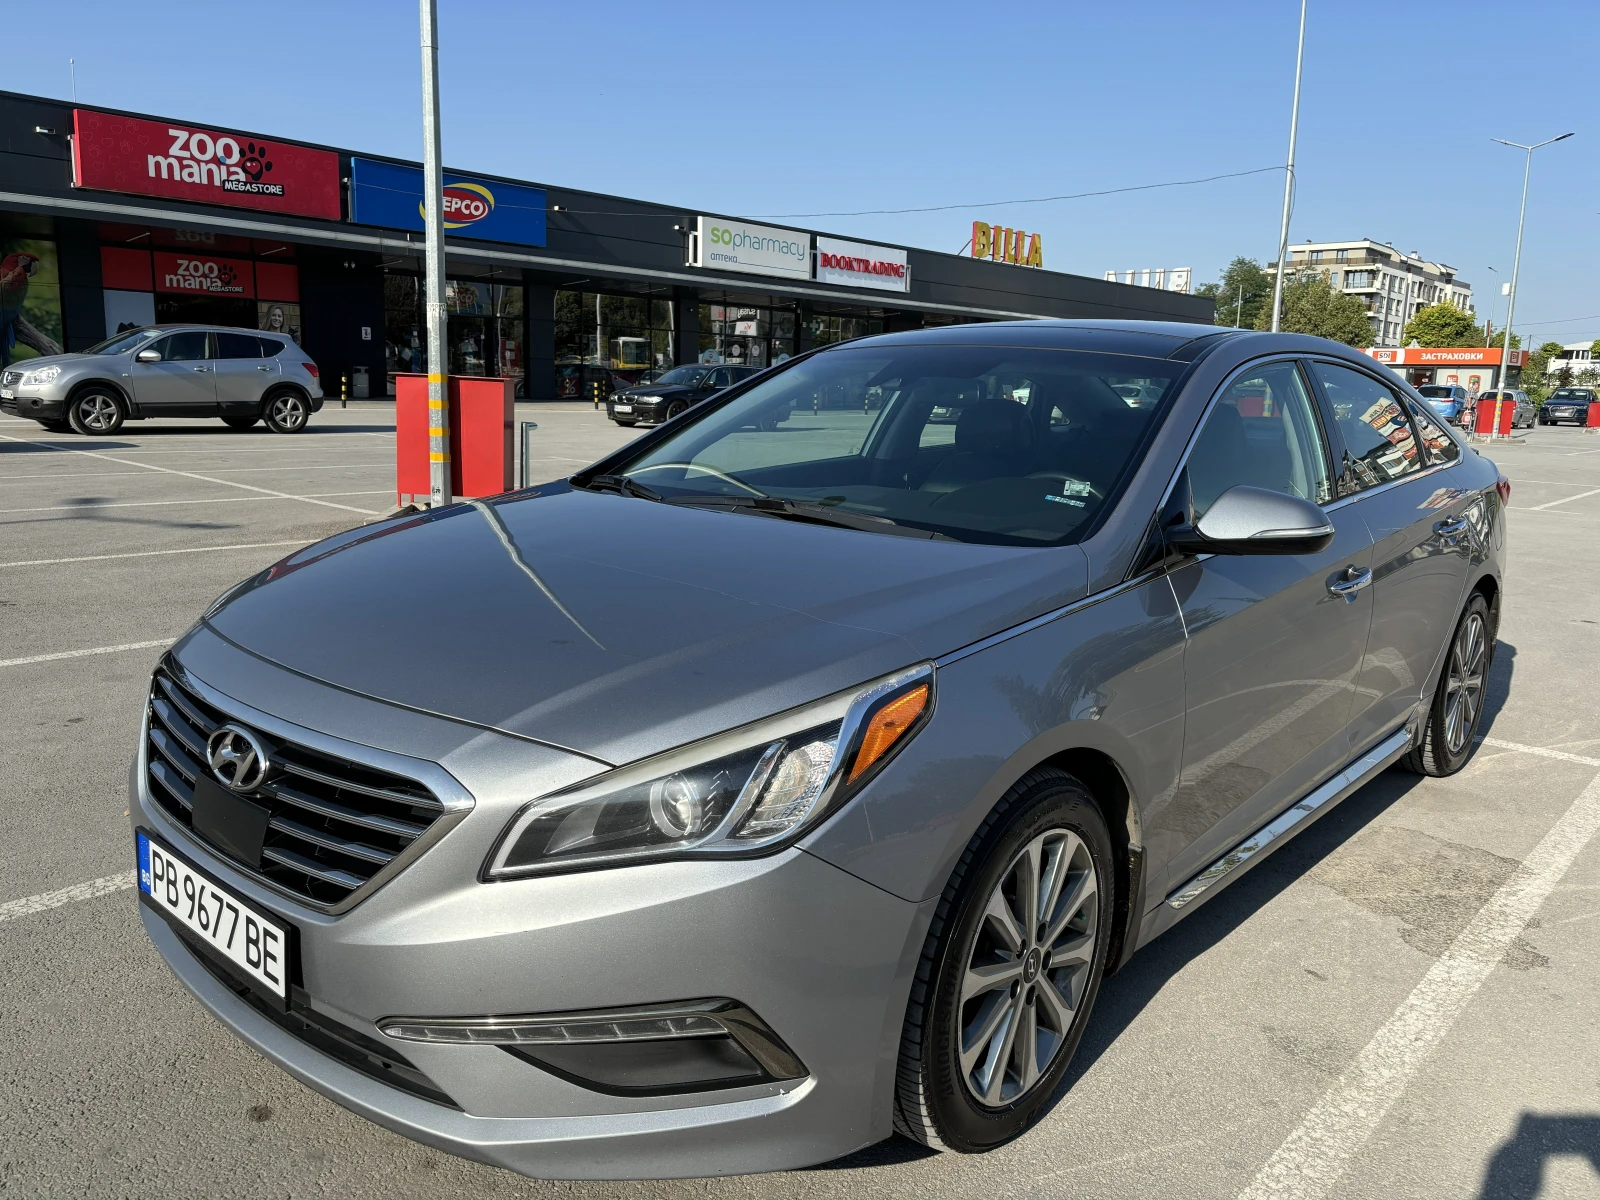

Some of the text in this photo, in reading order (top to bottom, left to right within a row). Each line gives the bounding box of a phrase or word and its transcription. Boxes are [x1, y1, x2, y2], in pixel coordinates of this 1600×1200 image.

[147, 154, 246, 187] mania
[224, 181, 283, 195] MEGASTORE
[443, 196, 484, 216] EPCO
[710, 226, 806, 261] sopharmacy
[971, 221, 1043, 269] BILLA
[710, 252, 738, 264] аптека
[820, 252, 905, 279] BOOKTRADING
[165, 273, 222, 290] mania
[1420, 352, 1484, 361] ЗАСТРАХОВКИ
[141, 868, 151, 886] BG
[152, 848, 280, 987] PB 9677 BE
